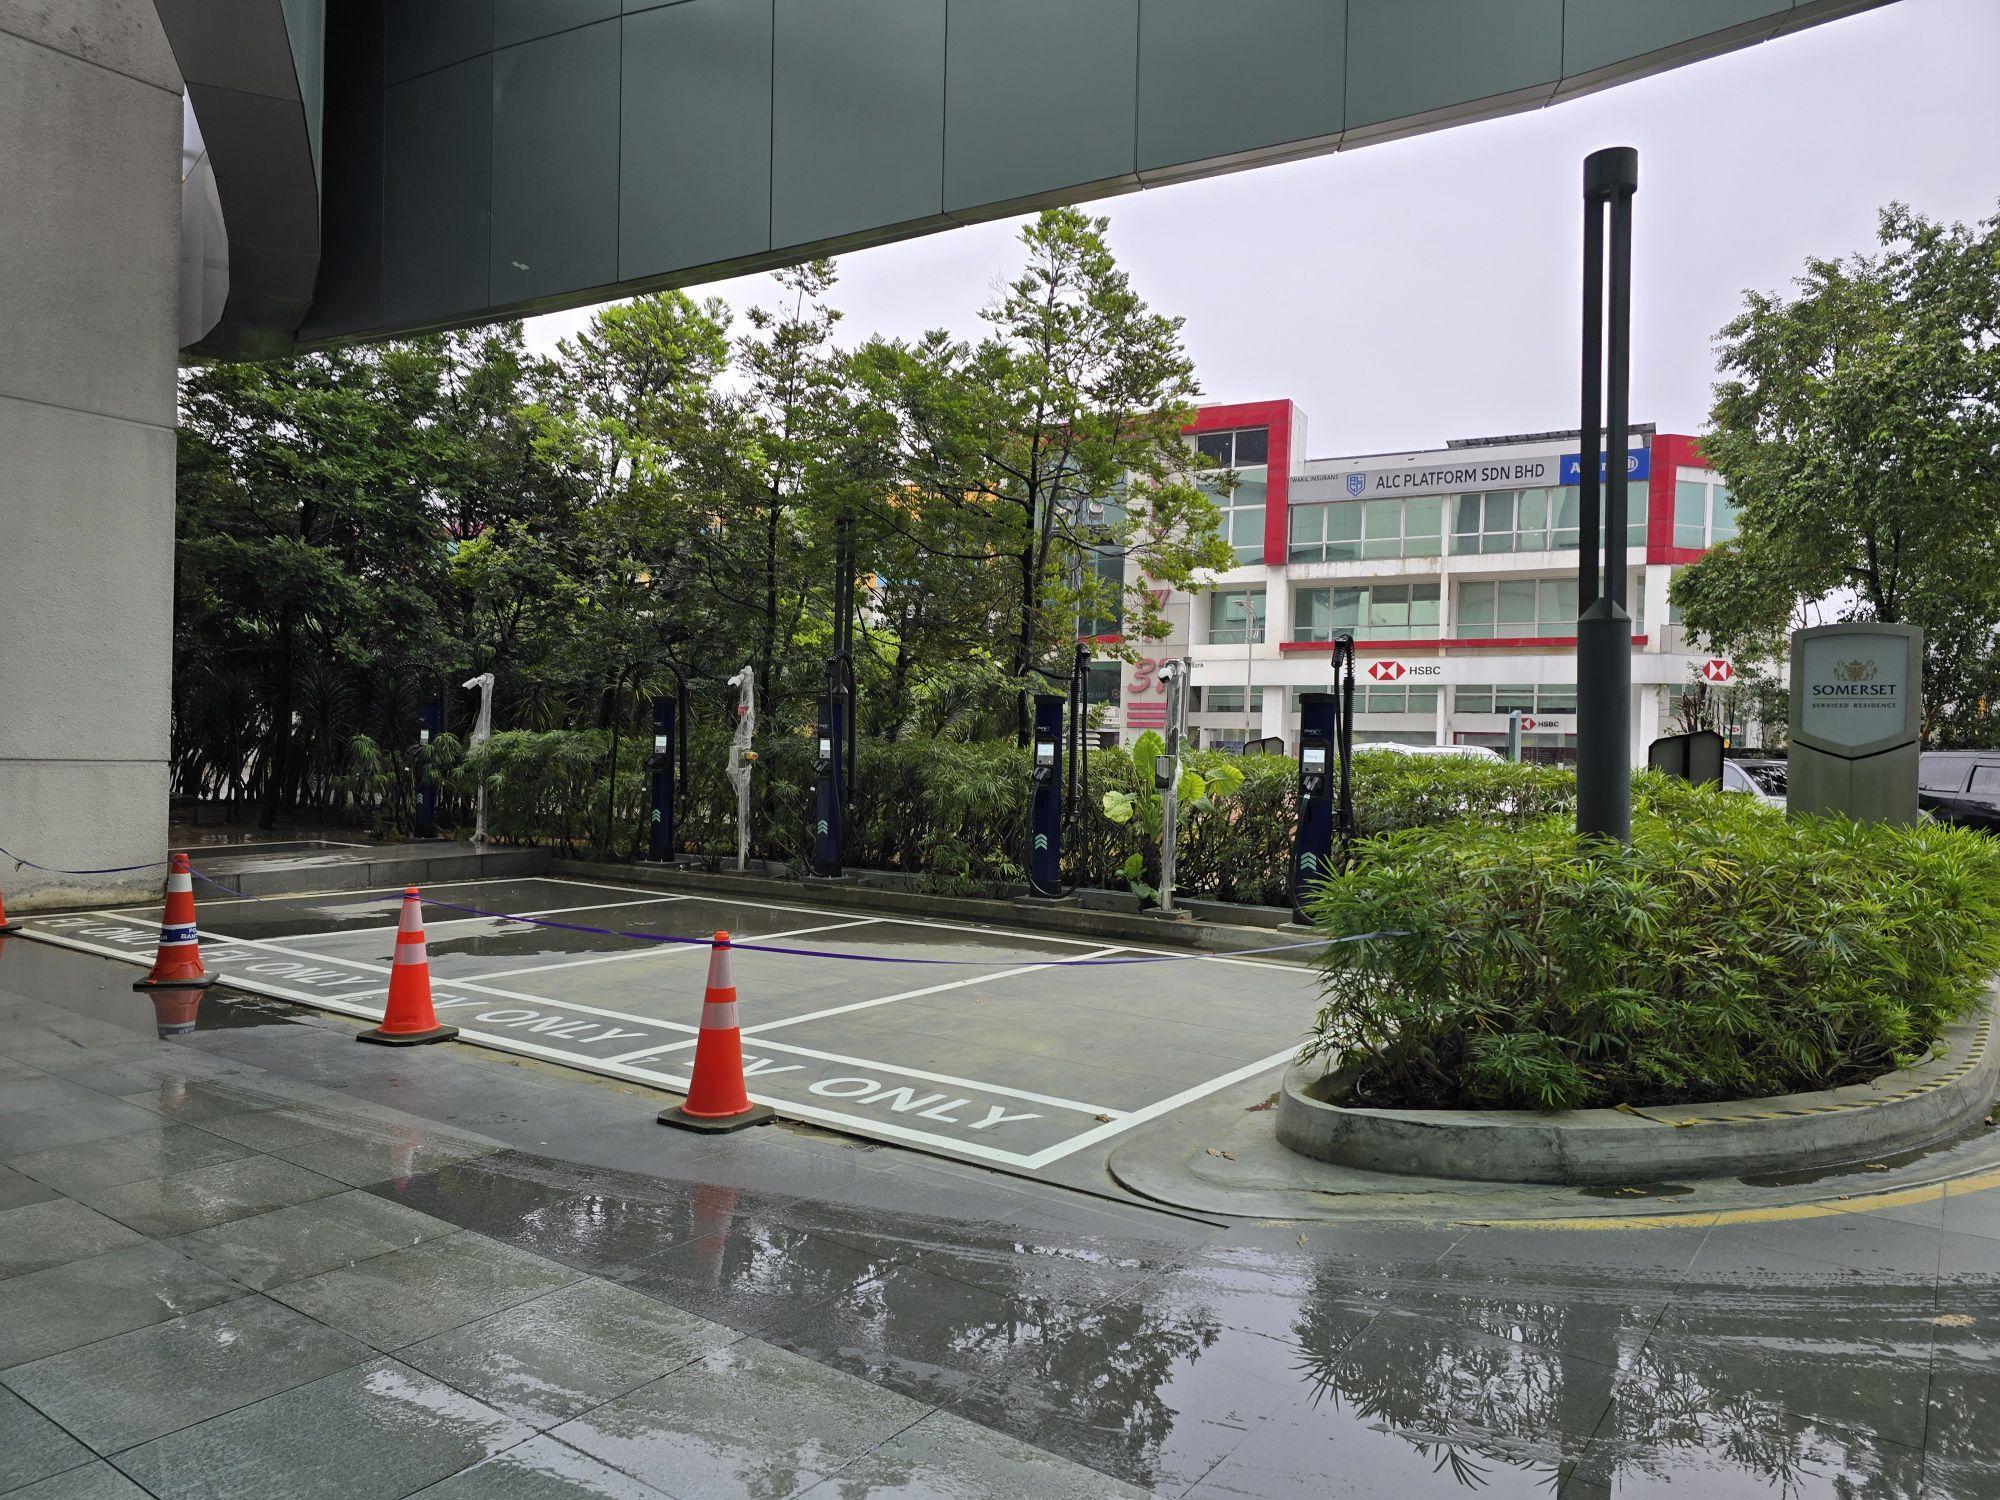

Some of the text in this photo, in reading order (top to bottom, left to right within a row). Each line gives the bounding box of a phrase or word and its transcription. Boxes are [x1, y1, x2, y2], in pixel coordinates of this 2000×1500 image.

[1375, 463, 1545, 490] ALC PLATFORM SDN BHD
[1409, 665, 1441, 675] HSBC
[1812, 684, 1897, 696] SOMERSET
[1538, 720, 1560, 728] HSBC
[78, 927, 163, 946] ONL
[245, 962, 381, 987] ONLY
[475, 1009, 649, 1043] ONLY
[808, 1077, 1045, 1130] ONLY
